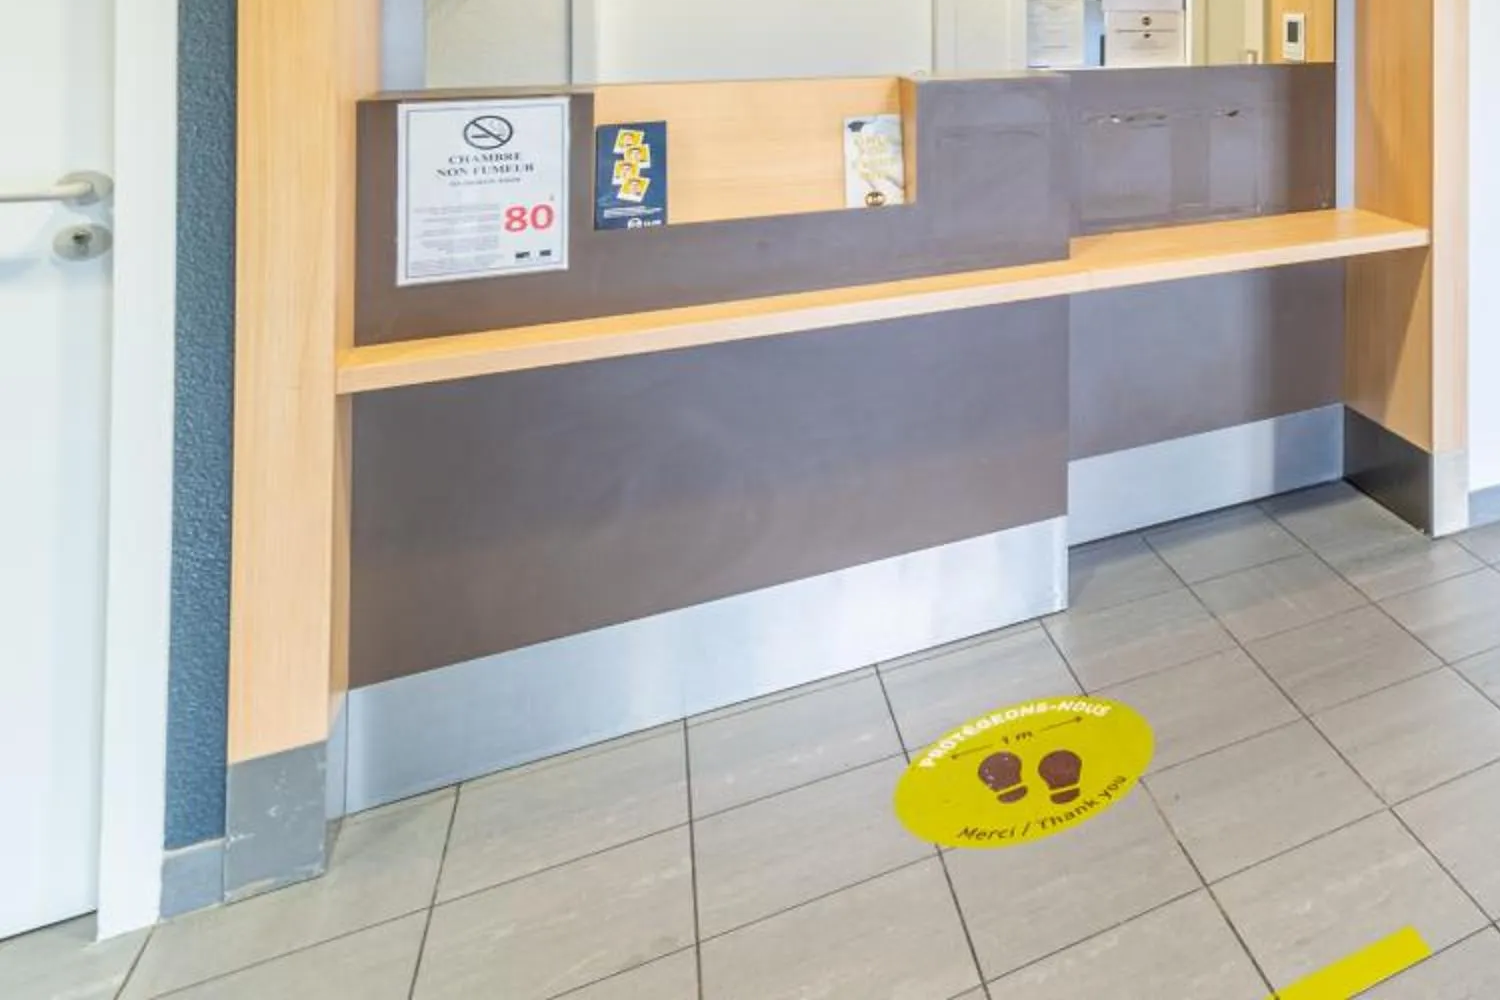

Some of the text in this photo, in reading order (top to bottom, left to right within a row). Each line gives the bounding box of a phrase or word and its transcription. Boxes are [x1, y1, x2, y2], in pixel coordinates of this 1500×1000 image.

[448, 152, 521, 165] CHAMBRE
[436, 167, 468, 177] NON
[504, 203, 554, 232] 80
[957, 825, 1016, 841] Merci
[1037, 798, 1099, 831] Thank
[1097, 774, 1128, 802] you
